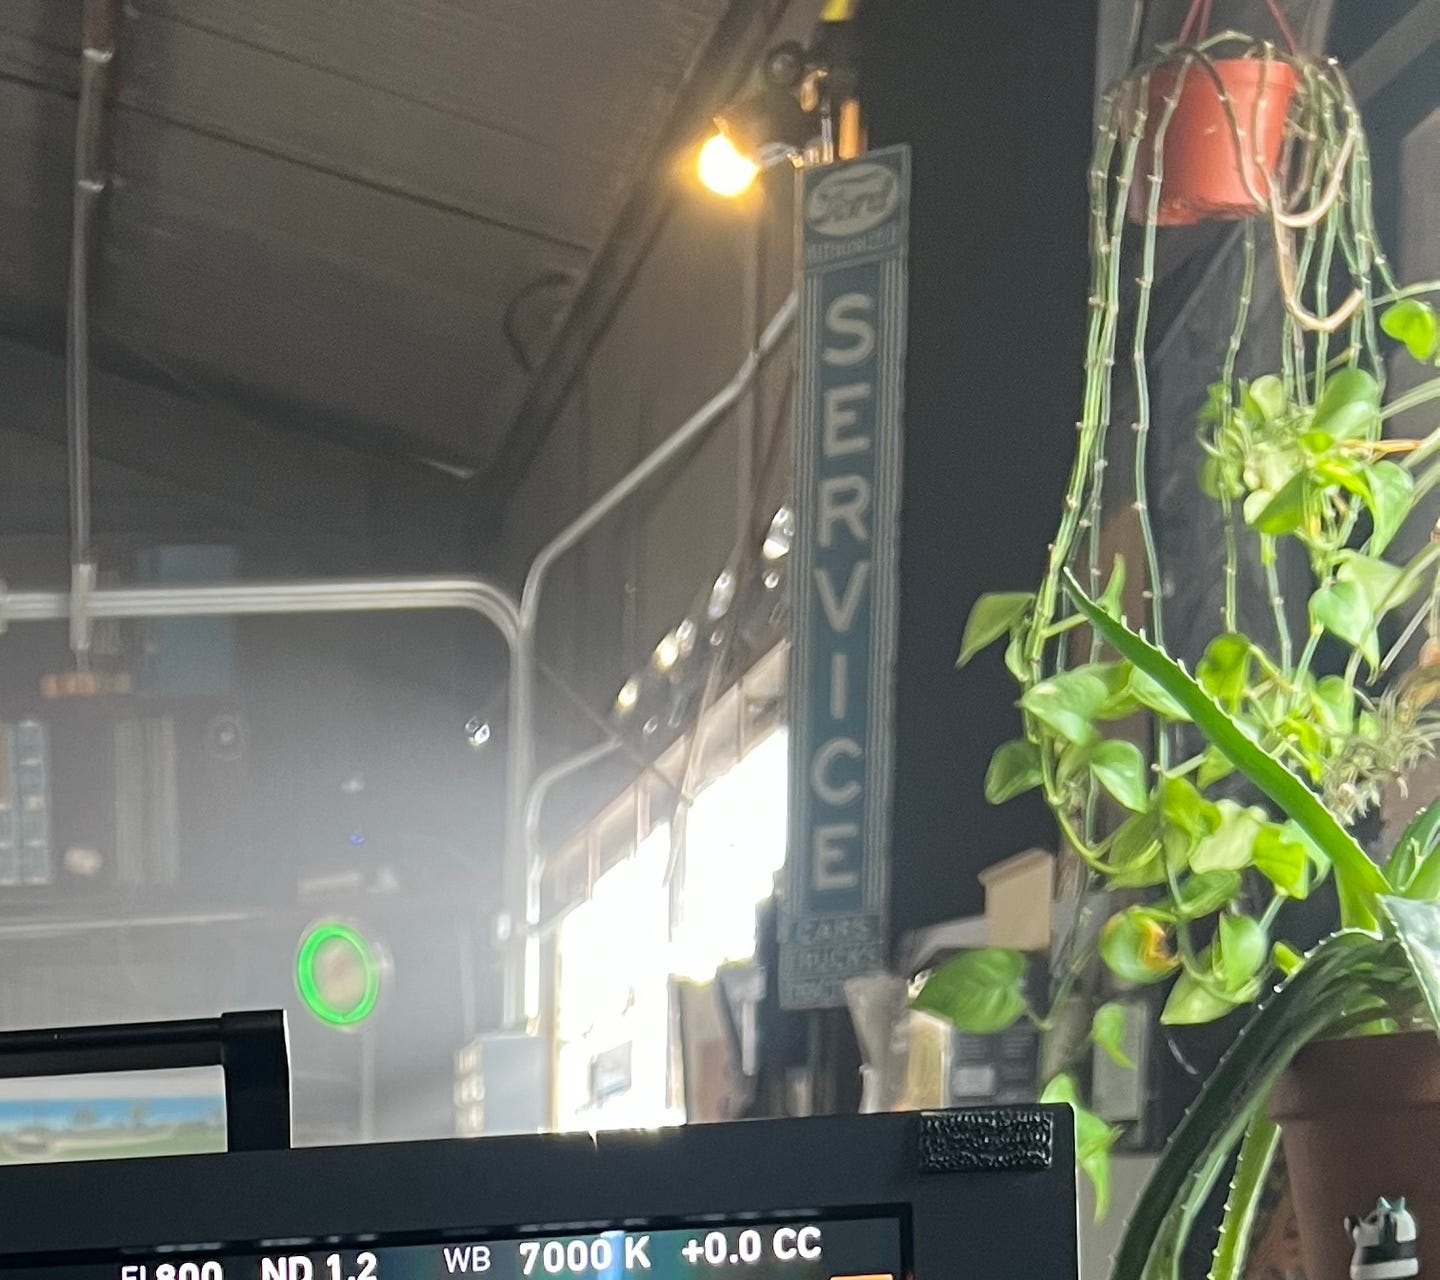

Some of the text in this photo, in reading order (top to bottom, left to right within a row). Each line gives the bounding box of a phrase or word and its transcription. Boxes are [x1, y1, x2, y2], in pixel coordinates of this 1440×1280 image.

[811, 291, 877, 892] SERVICE
[443, 1245, 492, 1274] WB
[518, 1237, 612, 1276] 7000
[624, 1234, 652, 1270] K
[681, 1228, 762, 1266] +0.0
[772, 1226, 823, 1260] CC
